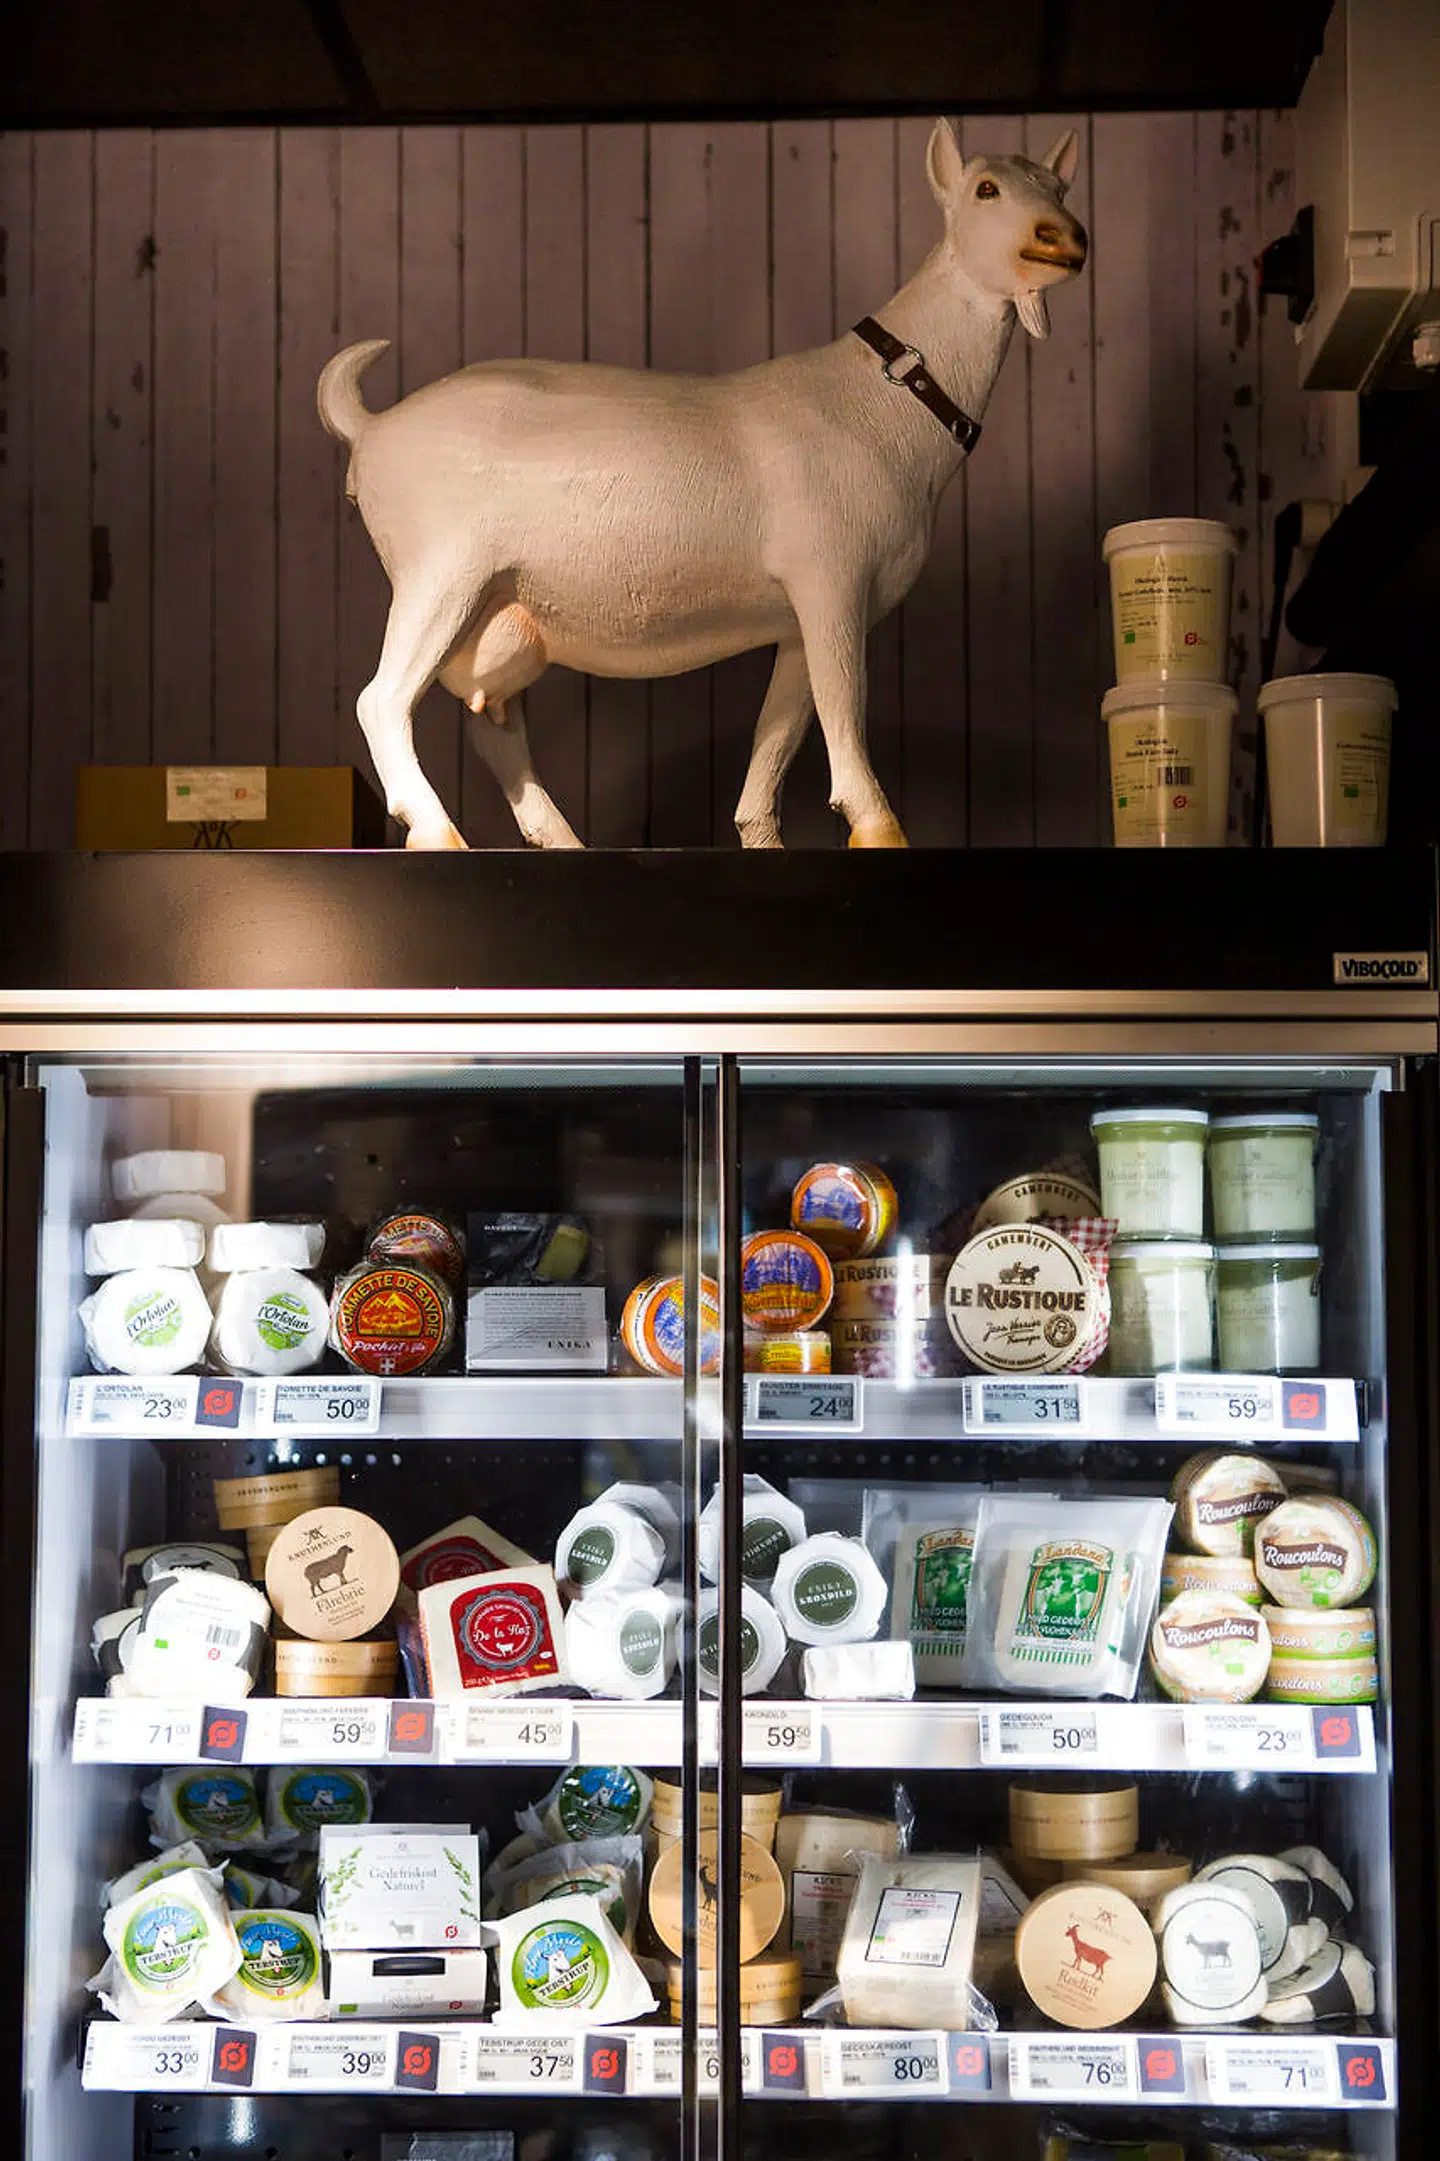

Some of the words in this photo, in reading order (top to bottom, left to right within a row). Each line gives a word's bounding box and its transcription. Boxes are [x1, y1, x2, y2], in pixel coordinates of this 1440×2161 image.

[1342, 958, 1418, 978] VIBOCOLD
[987, 1233, 1053, 1252] CAMEMBERT
[950, 1286, 973, 1307] LE
[977, 1282, 1085, 1311] RUSTIQUE
[258, 1304, 310, 1330] l'Ortolan
[396, 1276, 417, 1293] DE
[415, 1286, 440, 1340] SAVOIE
[547, 1339, 595, 1350] UNIKA
[143, 1399, 172, 1418] 23
[327, 1400, 354, 1419] 50
[810, 1397, 838, 1417] 24
[1035, 1399, 1060, 1418] 31
[1229, 1399, 1256, 1418] 59
[1264, 1543, 1345, 1567] Roucoulons
[1165, 1622, 1256, 1648] Roucoulons
[148, 1724, 172, 1744] 71
[332, 1723, 361, 1743] 59
[518, 1724, 547, 1744] 45
[767, 1726, 796, 1747] 59
[1053, 1728, 1081, 1749] 50
[1257, 1730, 1287, 1751] 23
[538, 1961, 590, 1996] TERSTRUP
[155, 2052, 183, 2074] 33
[342, 2053, 371, 2074] 39
[530, 2055, 558, 2077] 37
[894, 2057, 923, 2080] 80
[1081, 2063, 1111, 2085] 76
[1280, 2066, 1307, 2089] 71
